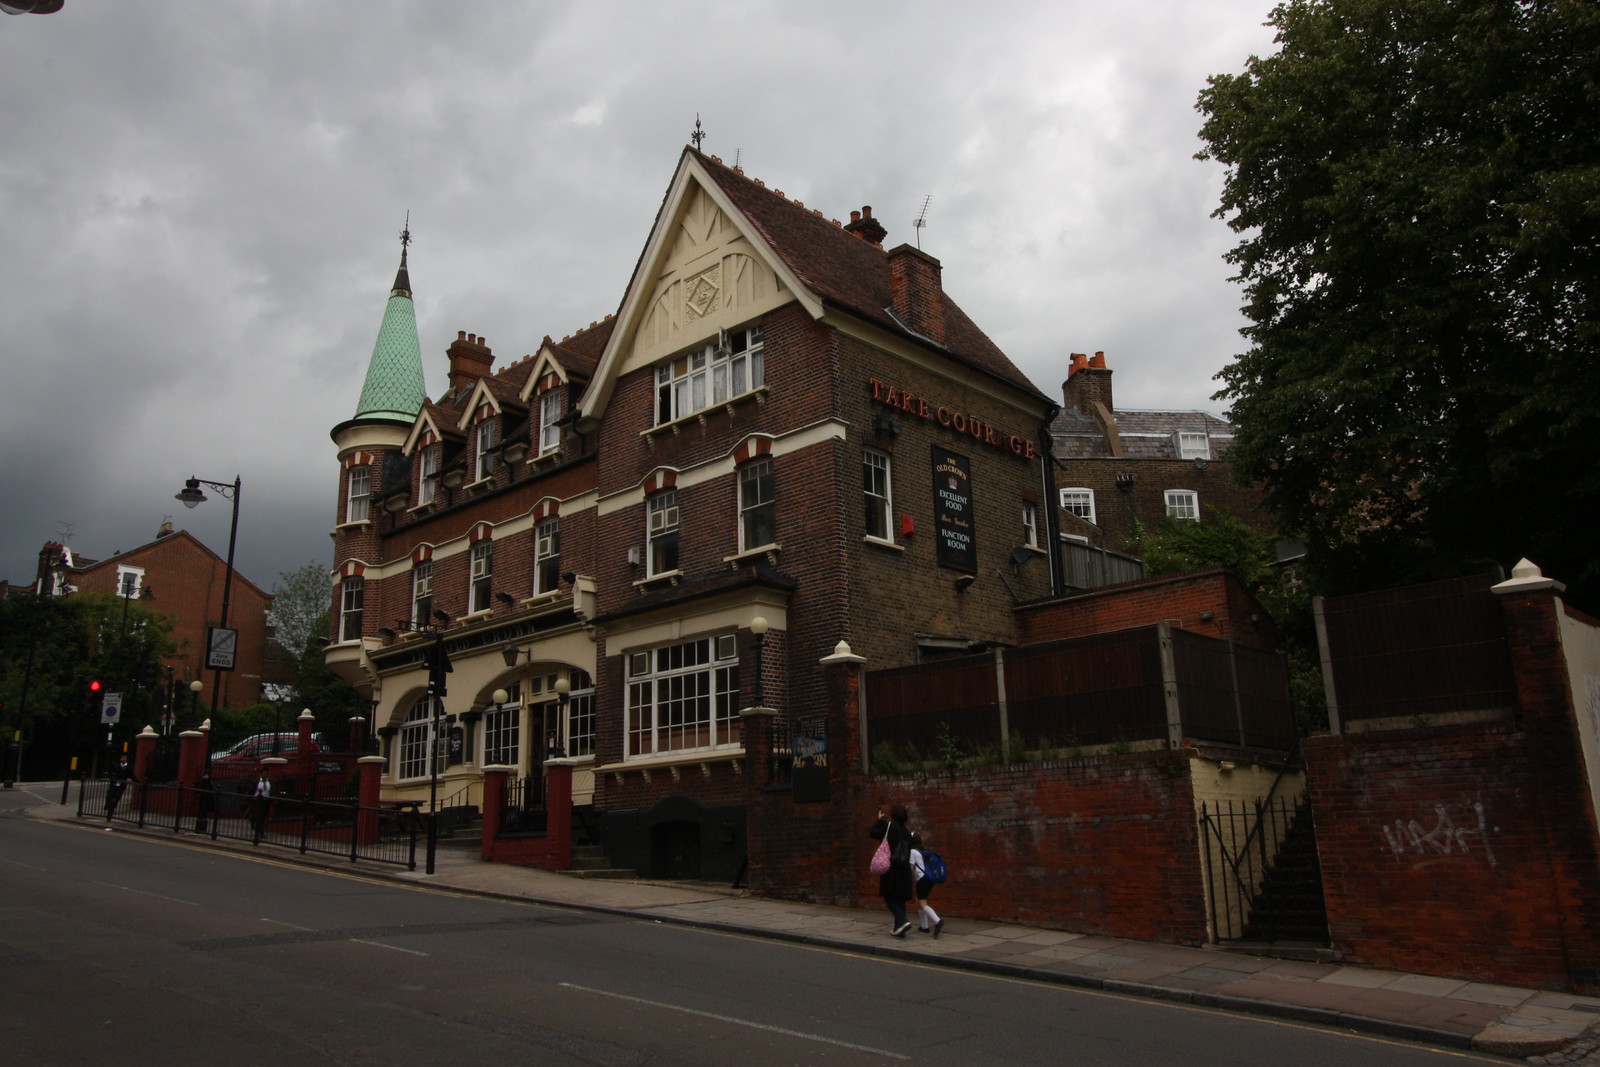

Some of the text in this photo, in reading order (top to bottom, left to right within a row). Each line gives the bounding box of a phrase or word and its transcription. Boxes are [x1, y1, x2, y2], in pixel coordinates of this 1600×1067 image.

[869, 377, 931, 420] TAKE
[946, 457, 956, 465] THE
[936, 464, 968, 480] OLD CROWN
[939, 489, 967, 505] EXCELLENT
[945, 500, 962, 511] FOOD
[941, 528, 970, 543] FUNCTION
[947, 538, 966, 551] ROOM
[212, 658, 231, 666] ENDS
